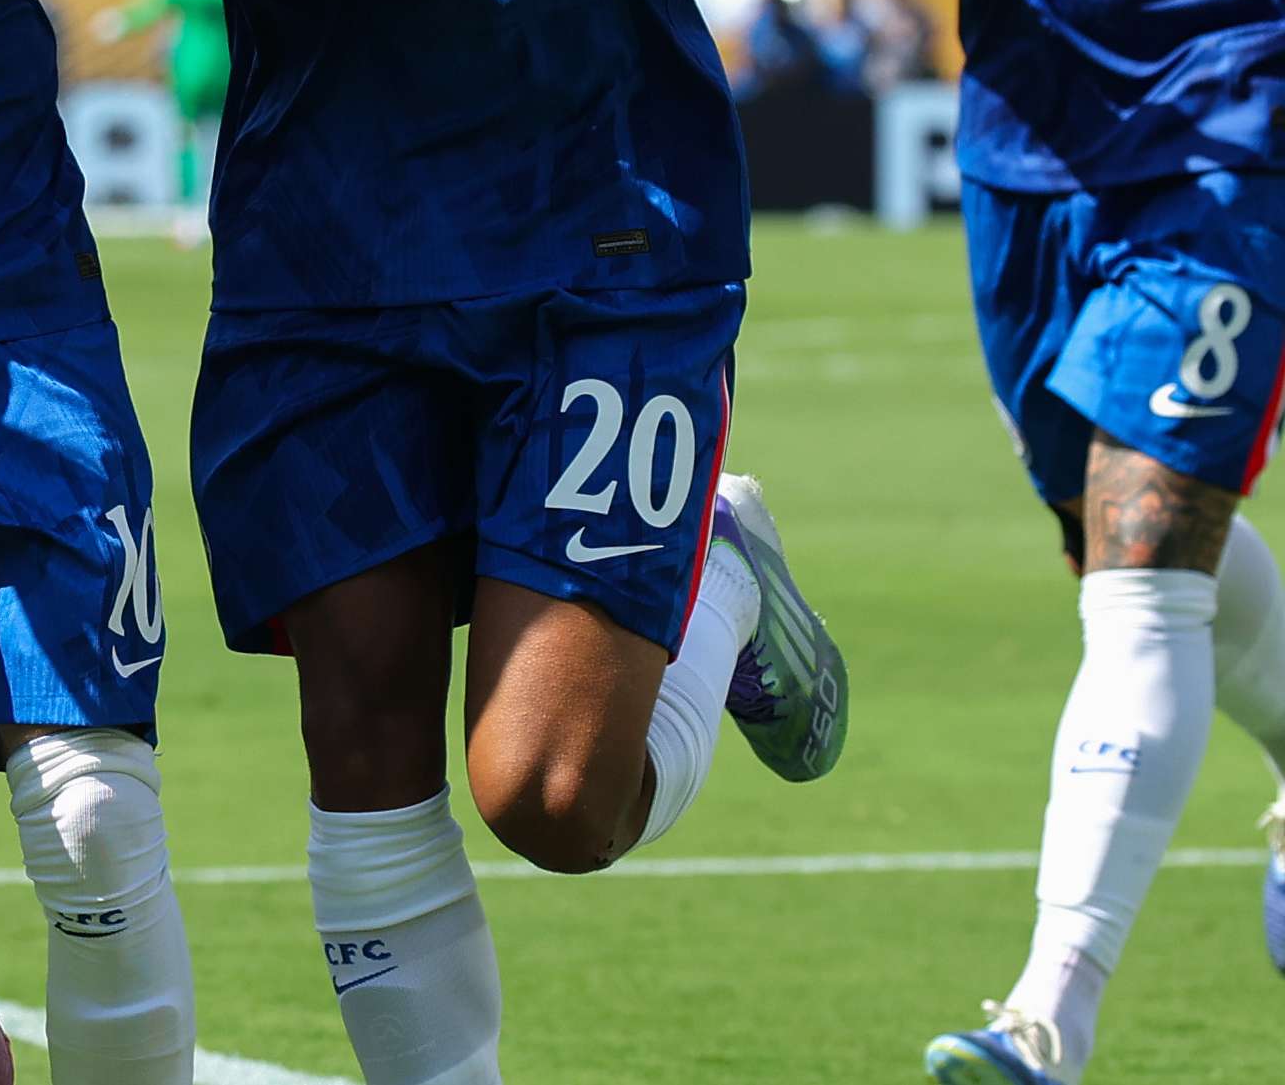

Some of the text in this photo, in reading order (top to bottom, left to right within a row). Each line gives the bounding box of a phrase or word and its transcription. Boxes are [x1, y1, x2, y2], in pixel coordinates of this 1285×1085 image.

[1180, 283, 1252, 399] 8
[544, 378, 696, 529] 20
[104, 505, 163, 644] 10
[324, 939, 392, 966] CFC
